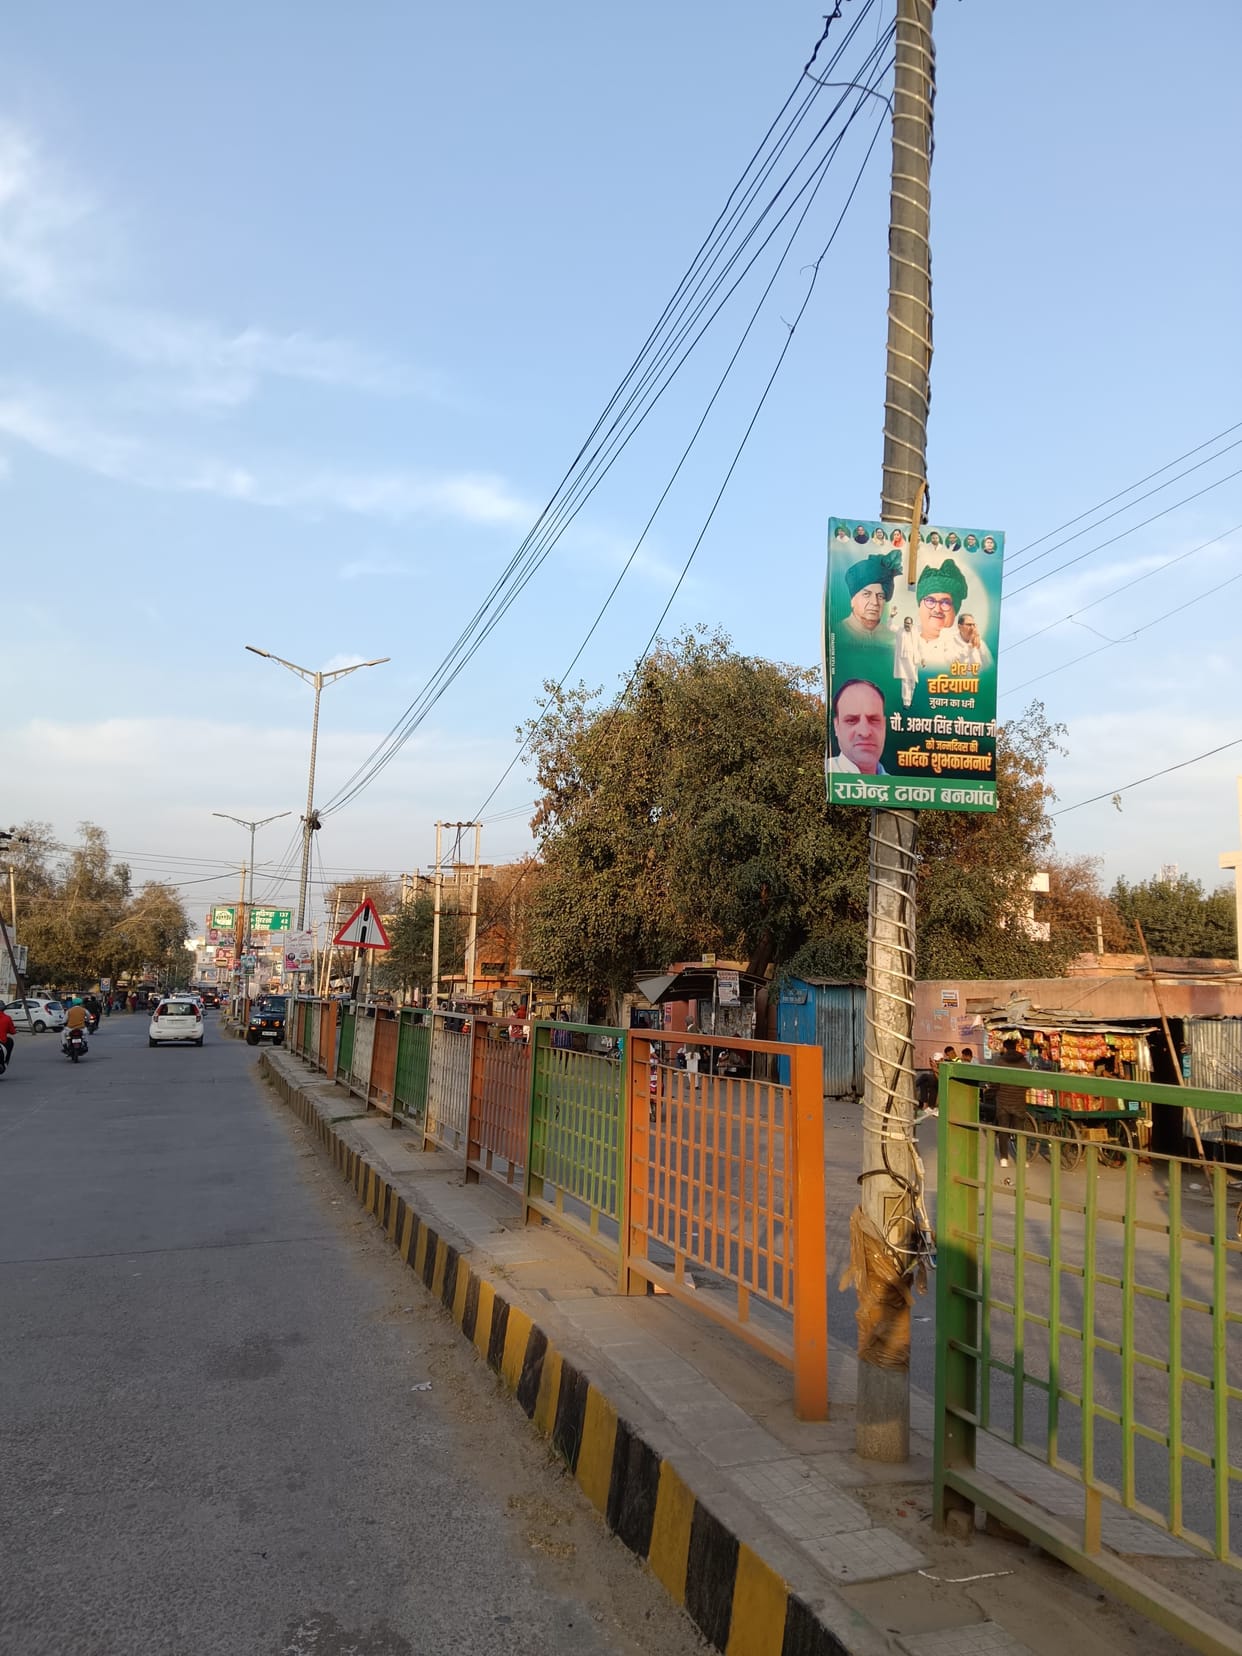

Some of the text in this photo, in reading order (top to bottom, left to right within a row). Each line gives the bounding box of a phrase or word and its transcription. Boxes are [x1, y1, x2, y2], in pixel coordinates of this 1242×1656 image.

[927, 674, 979, 694] हरियाणा
[949, 698, 960, 708] का
[961, 698, 975, 709] धनी
[890, 712, 997, 738] चौ. अभय सिंह चौटाला जी
[925, 737, 978, 752] को जन्मदिवस की
[897, 745, 993, 774] हार्दिक शुभकामनाएं
[834, 779, 995, 806] राजेन्द्र ढाका बनगांव
